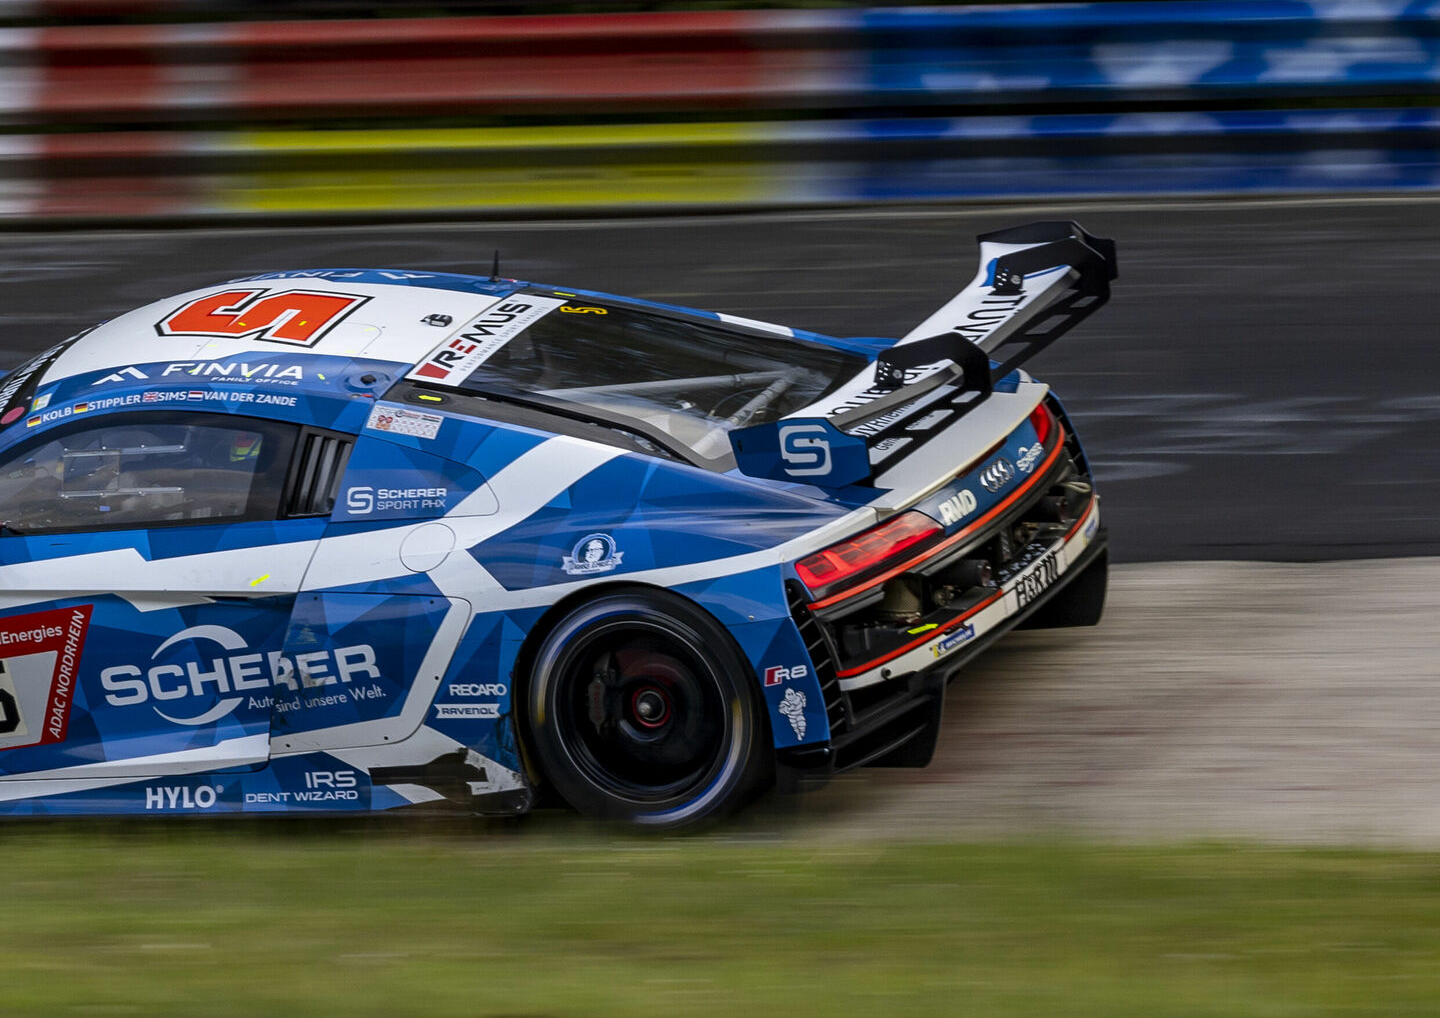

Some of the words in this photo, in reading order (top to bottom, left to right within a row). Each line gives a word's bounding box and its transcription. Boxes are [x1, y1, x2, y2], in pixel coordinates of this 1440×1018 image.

[154, 288, 375, 348] 5
[433, 303, 533, 369] REMUS
[161, 362, 303, 379] FINVIA
[255, 378, 299, 386] OFFICE
[42, 406, 72, 422] KOLB
[88, 394, 141, 411] STIPPLER
[157, 391, 187, 402] SIMS
[203, 391, 228, 401] VAN
[230, 392, 254, 402] DER
[255, 394, 297, 407] ZANDE
[377, 499, 418, 510] SPORT
[421, 498, 446, 509] PHX
[938, 489, 978, 527] RWD
[56, 609, 85, 698] NORDRHEIN
[100, 644, 381, 707] SCHERER
[768, 665, 808, 684] R8
[275, 696, 301, 713] sind
[304, 693, 347, 709] unsere
[348, 684, 387, 701] Welt.
[449, 683, 507, 696] RECARO
[48, 696, 67, 739] ADAC
[305, 770, 357, 789] IRS
[245, 792, 289, 804] DENT
[292, 790, 359, 802] WIZARD
